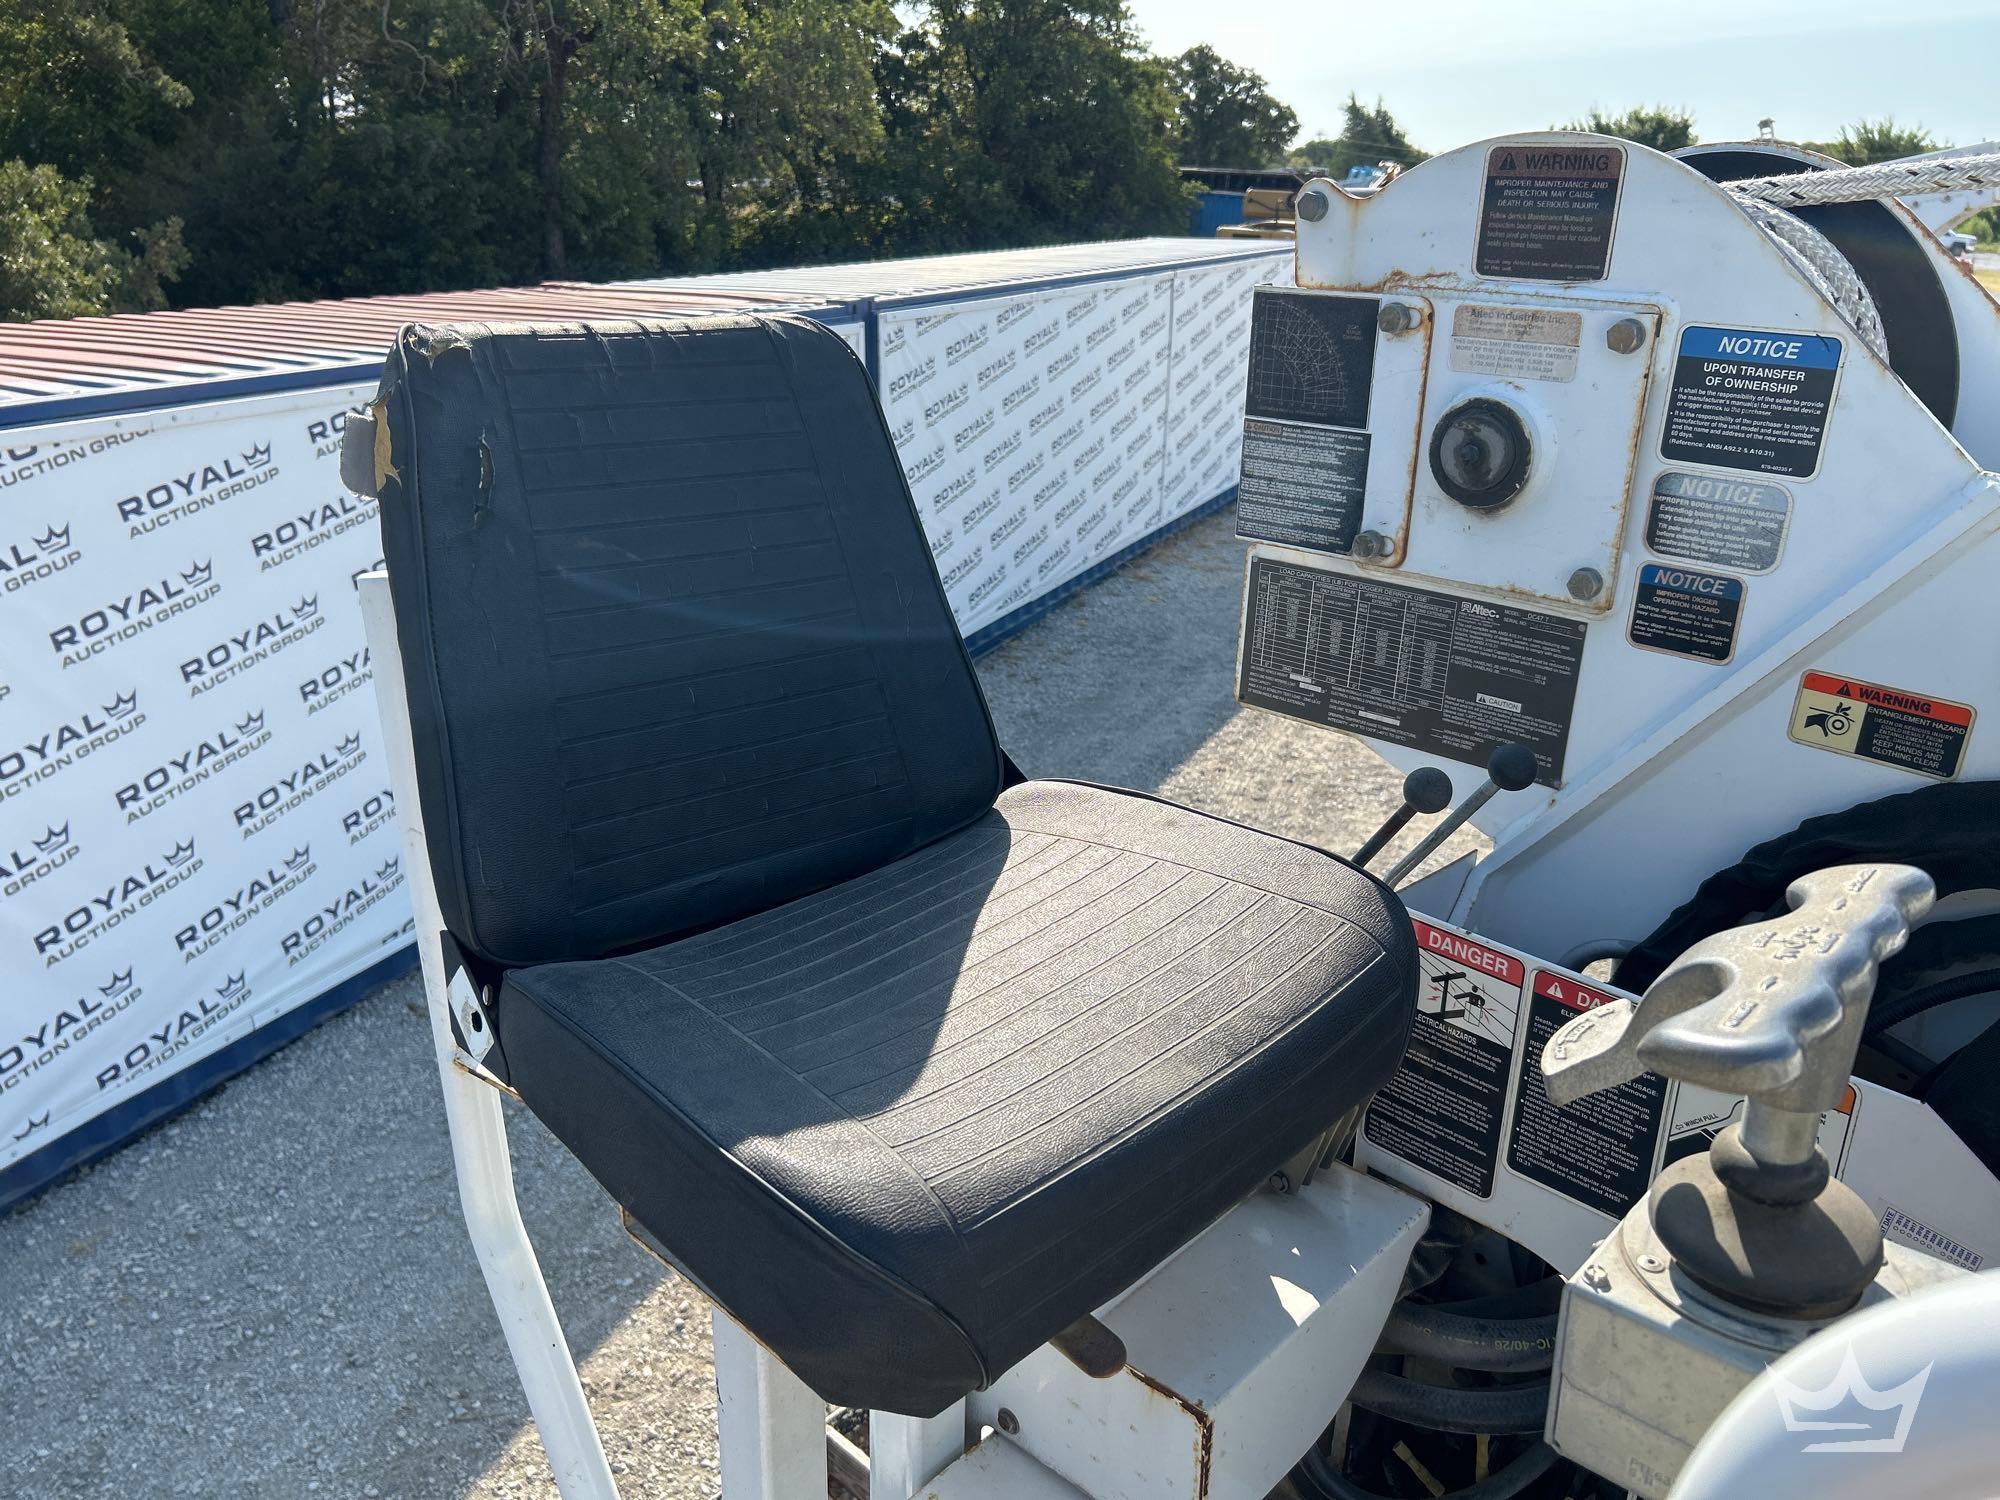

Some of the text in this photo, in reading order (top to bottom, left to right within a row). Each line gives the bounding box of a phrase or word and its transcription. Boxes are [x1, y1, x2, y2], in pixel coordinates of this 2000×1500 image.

[1524, 152, 1609, 171] WARNING
[1494, 178, 1531, 186] IMPROPER
[1534, 180, 1589, 188] MAINTENANCE
[1503, 188, 1547, 197] INSPECTION
[1568, 190, 1595, 198] CAUSE
[1536, 200, 1569, 208] SERIOUS
[1496, 311, 1545, 322] Industries
[1717, 336, 1802, 359] NOTICE
[1703, 362, 1805, 381] UPON TRANSFER
[1705, 376, 1798, 394] OF OWNERSHIP
[1716, 391, 1755, 402] responsibility
[1800, 400, 1824, 409] provide
[1800, 407, 1820, 415] device
[1705, 442, 1722, 450] ANSI
[118, 457, 245, 522] ROYAL
[130, 466, 280, 539] AUCTION GROUP
[1678, 477, 1765, 505] NOTICE
[1653, 495, 1784, 520] IMPROPER BOOM OPERATION HAZARD
[1659, 504, 1693, 515] Extending
[252, 497, 356, 556] ROYAL
[261, 529, 332, 573] AUCTION
[4, 550, 82, 592] GROUP
[1296, 571, 1330, 583] CAPACITIES
[1358, 584, 1383, 593] DIGGER
[1384, 589, 1412, 599] DERRICK
[1654, 569, 1728, 595] NOTICE
[1652, 596, 1720, 614] OPERATION HAZARD
[1656, 589, 1718, 606] IMPROPER DIGGER
[50, 576, 185, 653] ROYAL
[62, 582, 221, 670] AUCTION GROUP
[180, 613, 293, 684] ROYAL
[191, 616, 325, 698] AUCTION GROUP
[1488, 698, 1518, 710] CAUTION
[1857, 687, 1932, 713] WARNING
[1867, 706, 1965, 735] ENTANGLEMENT HAZARD
[1873, 717, 1893, 726] DEATH
[1902, 724, 1931, 735] SERIOUS
[1931, 731, 1952, 740] INJURY
[1881, 724, 1943, 743] COULD RESULT FROM
[75, 713, 147, 759] GROUP
[1872, 738, 1942, 761] KEEP HANDS AND
[1878, 729, 1942, 748] ENTANGLEMENT WITH
[115, 730, 238, 810] ROYAL
[1871, 746, 1939, 768] CLOTHING CLEAR
[126, 730, 272, 824] AUCTION GROUP
[234, 753, 339, 828] ROYAL
[242, 751, 367, 840] AUCTION GROUP
[4, 845, 80, 897] GROUP
[34, 864, 168, 955] ROYAL
[46, 858, 204, 968] AUCTION GROUP
[175, 868, 287, 952] ROYAL
[186, 863, 317, 964] AUCTION GROUP
[281, 878, 378, 957] ROYAL
[289, 874, 405, 968] AUCTION GROUP
[1428, 930, 1508, 977] DANGER
[74, 988, 142, 1042] GROUP
[191, 990, 253, 1039] GROUP
[96, 999, 222, 1089] ROYAL
[1447, 1026, 1476, 1046] HAZARDS
[1619, 1098, 1649, 1113] minimum
[1620, 1084, 1646, 1099] Remove
[1572, 1103, 1633, 1133] below the minimum
[1606, 1099, 1639, 1115] personnel
[1684, 1113, 1718, 1128] WINCH PULL
[1524, 1100, 1541, 1111] Never
[1543, 1108, 1559, 1119] allow
[1560, 1116, 1577, 1127] metal
[1578, 1124, 1617, 1145] components
[1598, 1121, 1633, 1140] electrically
[1517, 1145, 1598, 1187] Dielectrically test regular
[1520, 1128, 1618, 1177] Keep fiberglass upper boom and
[1885, 1210, 1894, 1226] DATE
